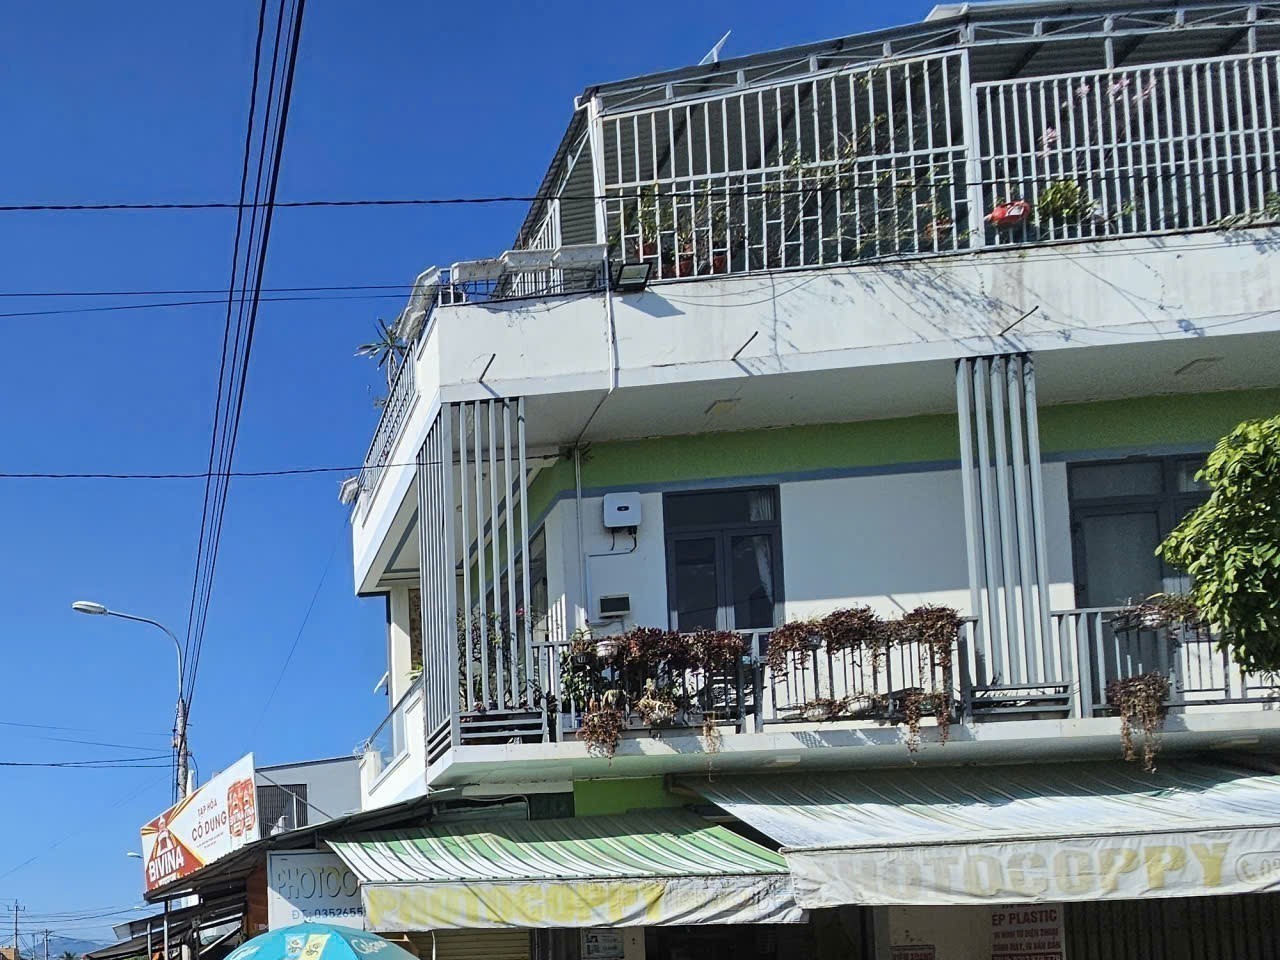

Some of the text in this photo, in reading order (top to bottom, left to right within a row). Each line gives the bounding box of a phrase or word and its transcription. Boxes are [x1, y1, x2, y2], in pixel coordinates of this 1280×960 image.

[204, 810, 227, 835] DUNG
[148, 846, 185, 883] BIVINA
[1008, 909, 1057, 925] PLASTIC
